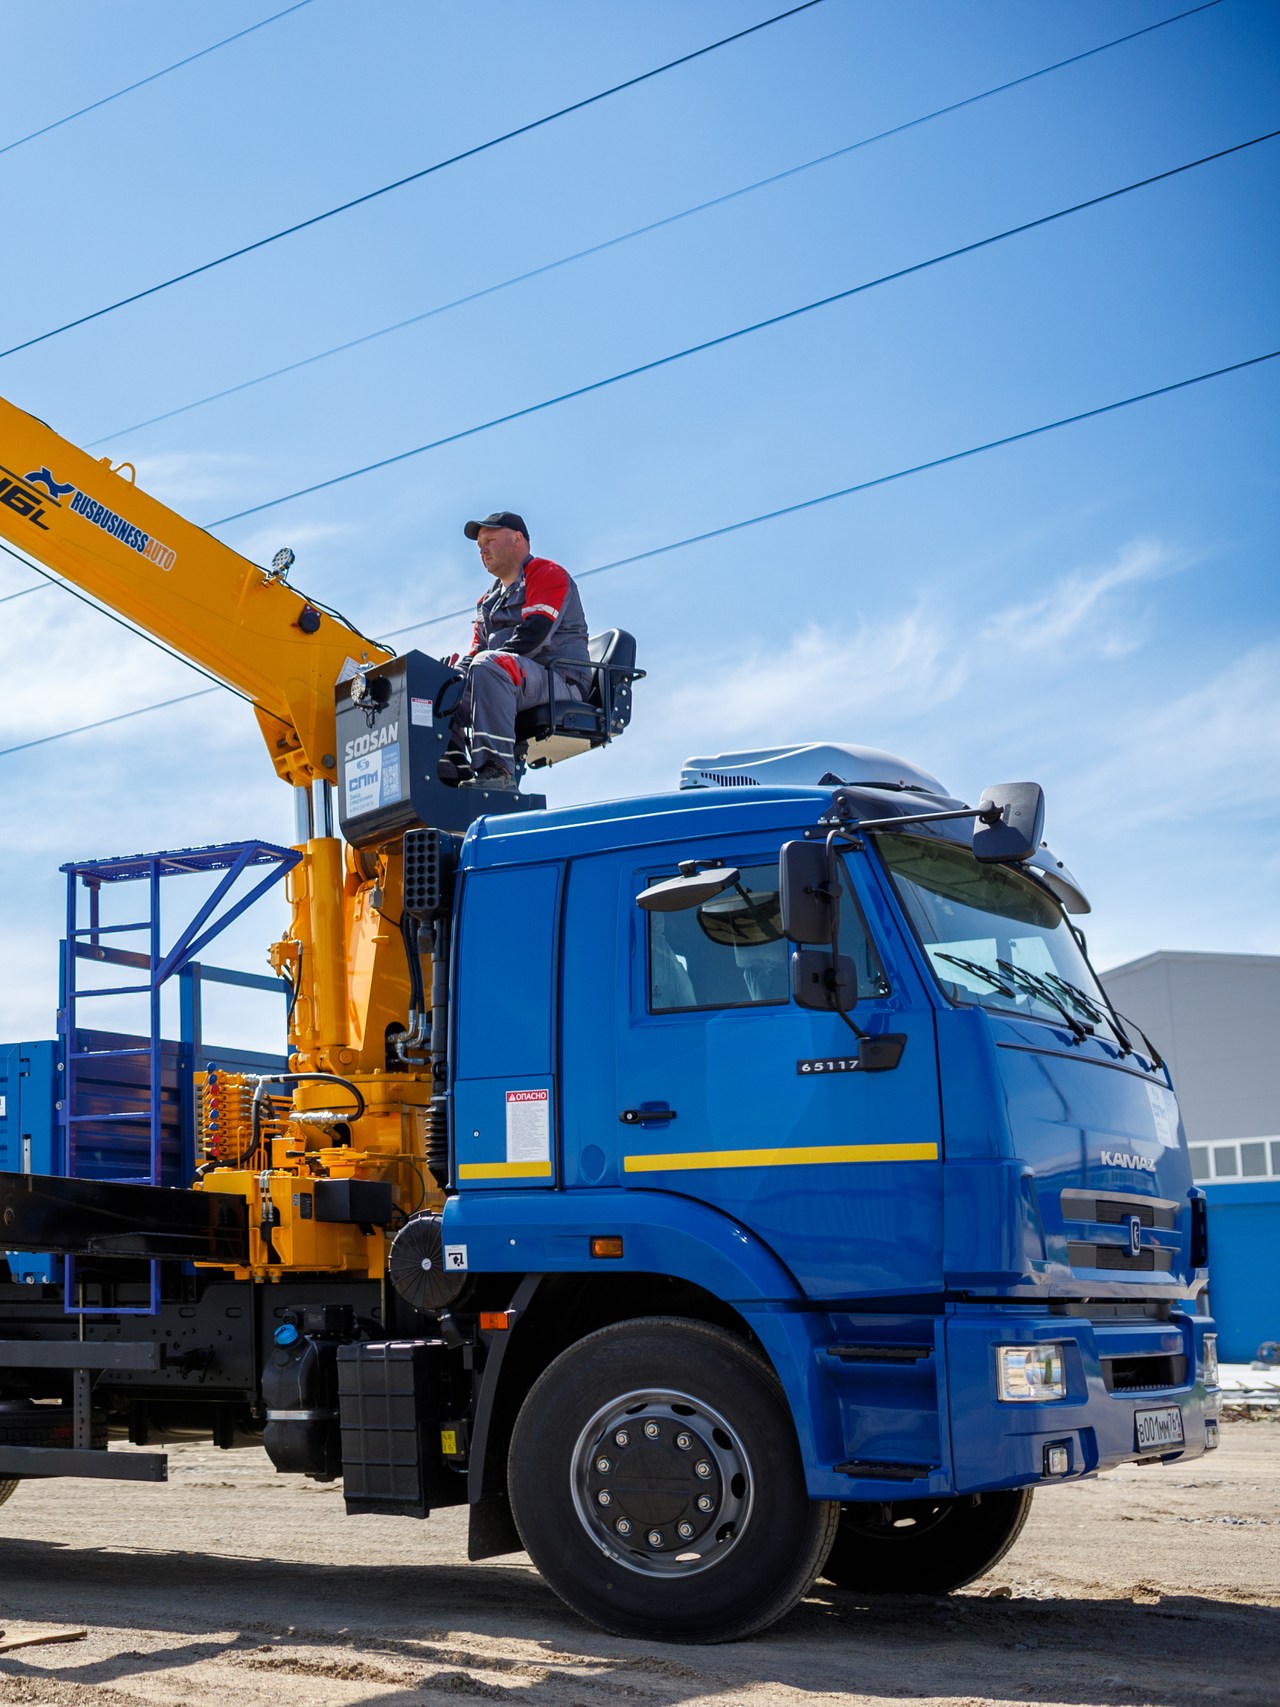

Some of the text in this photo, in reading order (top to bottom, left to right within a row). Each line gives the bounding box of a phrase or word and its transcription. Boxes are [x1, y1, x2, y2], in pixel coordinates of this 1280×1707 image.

[69, 491, 177, 572] RUSBUSINESSAUTO
[345, 721, 399, 762] SOOSAN
[801, 1060, 858, 1072] 65117
[516, 1092, 547, 1101] ОПАСНО
[1101, 1150, 1156, 1172] KAMAZ
